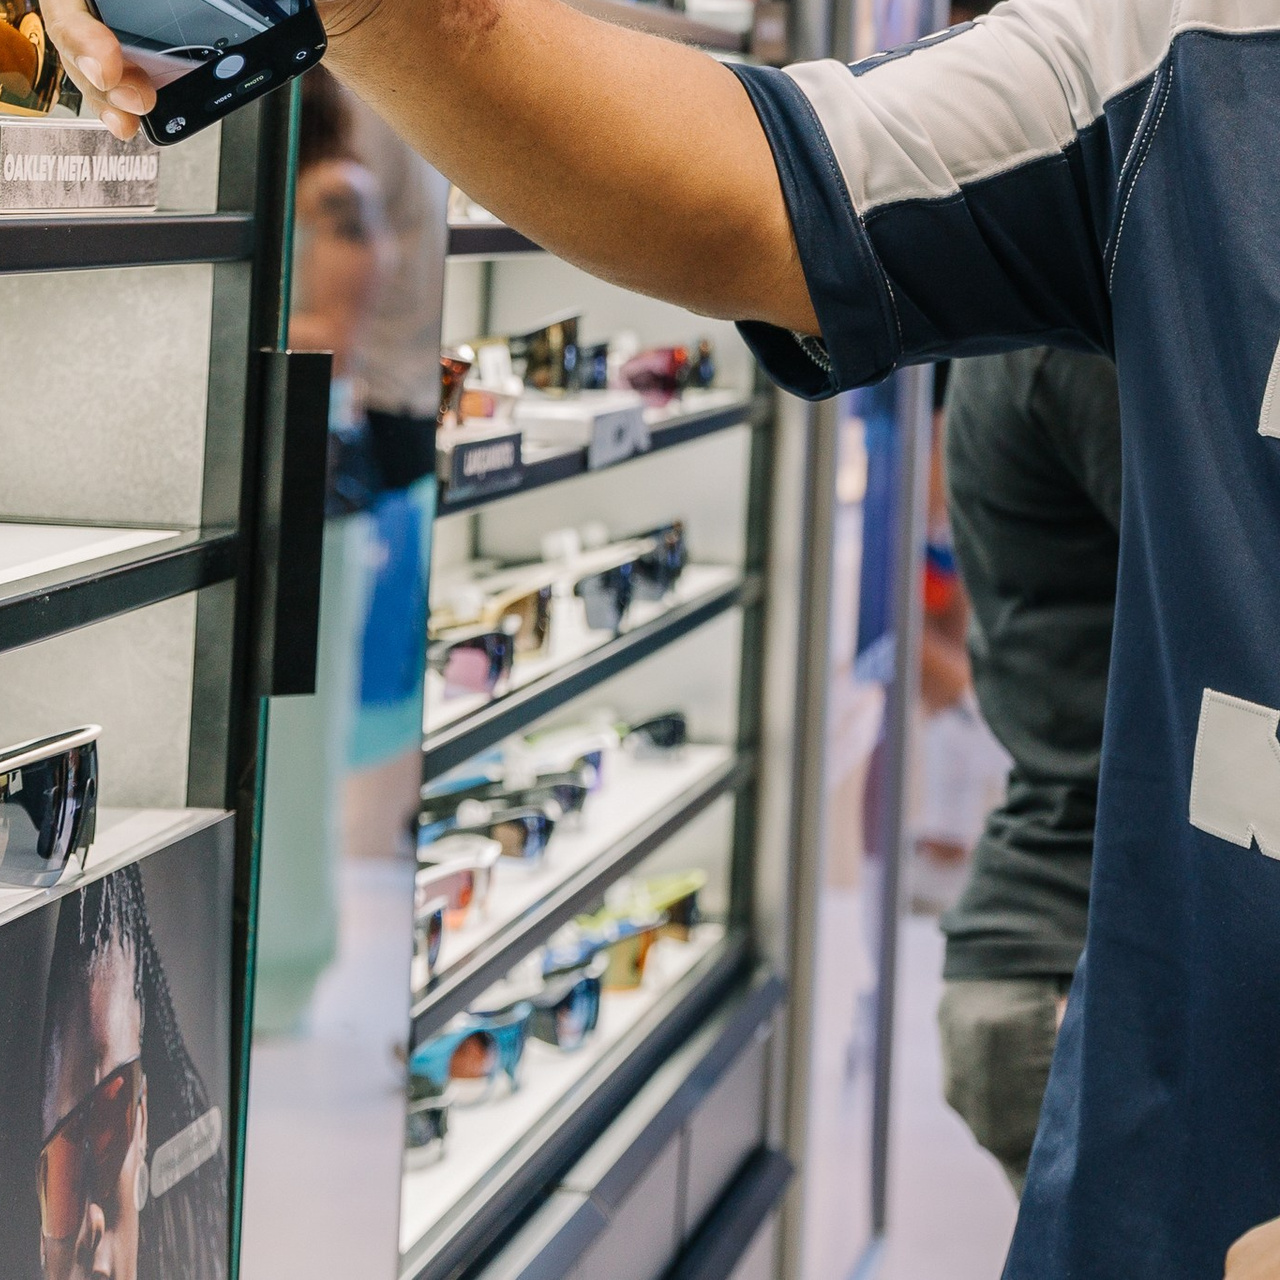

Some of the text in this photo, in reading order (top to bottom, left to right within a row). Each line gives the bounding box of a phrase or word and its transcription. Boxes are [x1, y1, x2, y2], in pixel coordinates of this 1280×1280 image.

[244, 75, 264, 89] PHOTO
[214, 92, 232, 105] VIDEO
[3, 153, 159, 182] OAKLEY META VANGUARD
